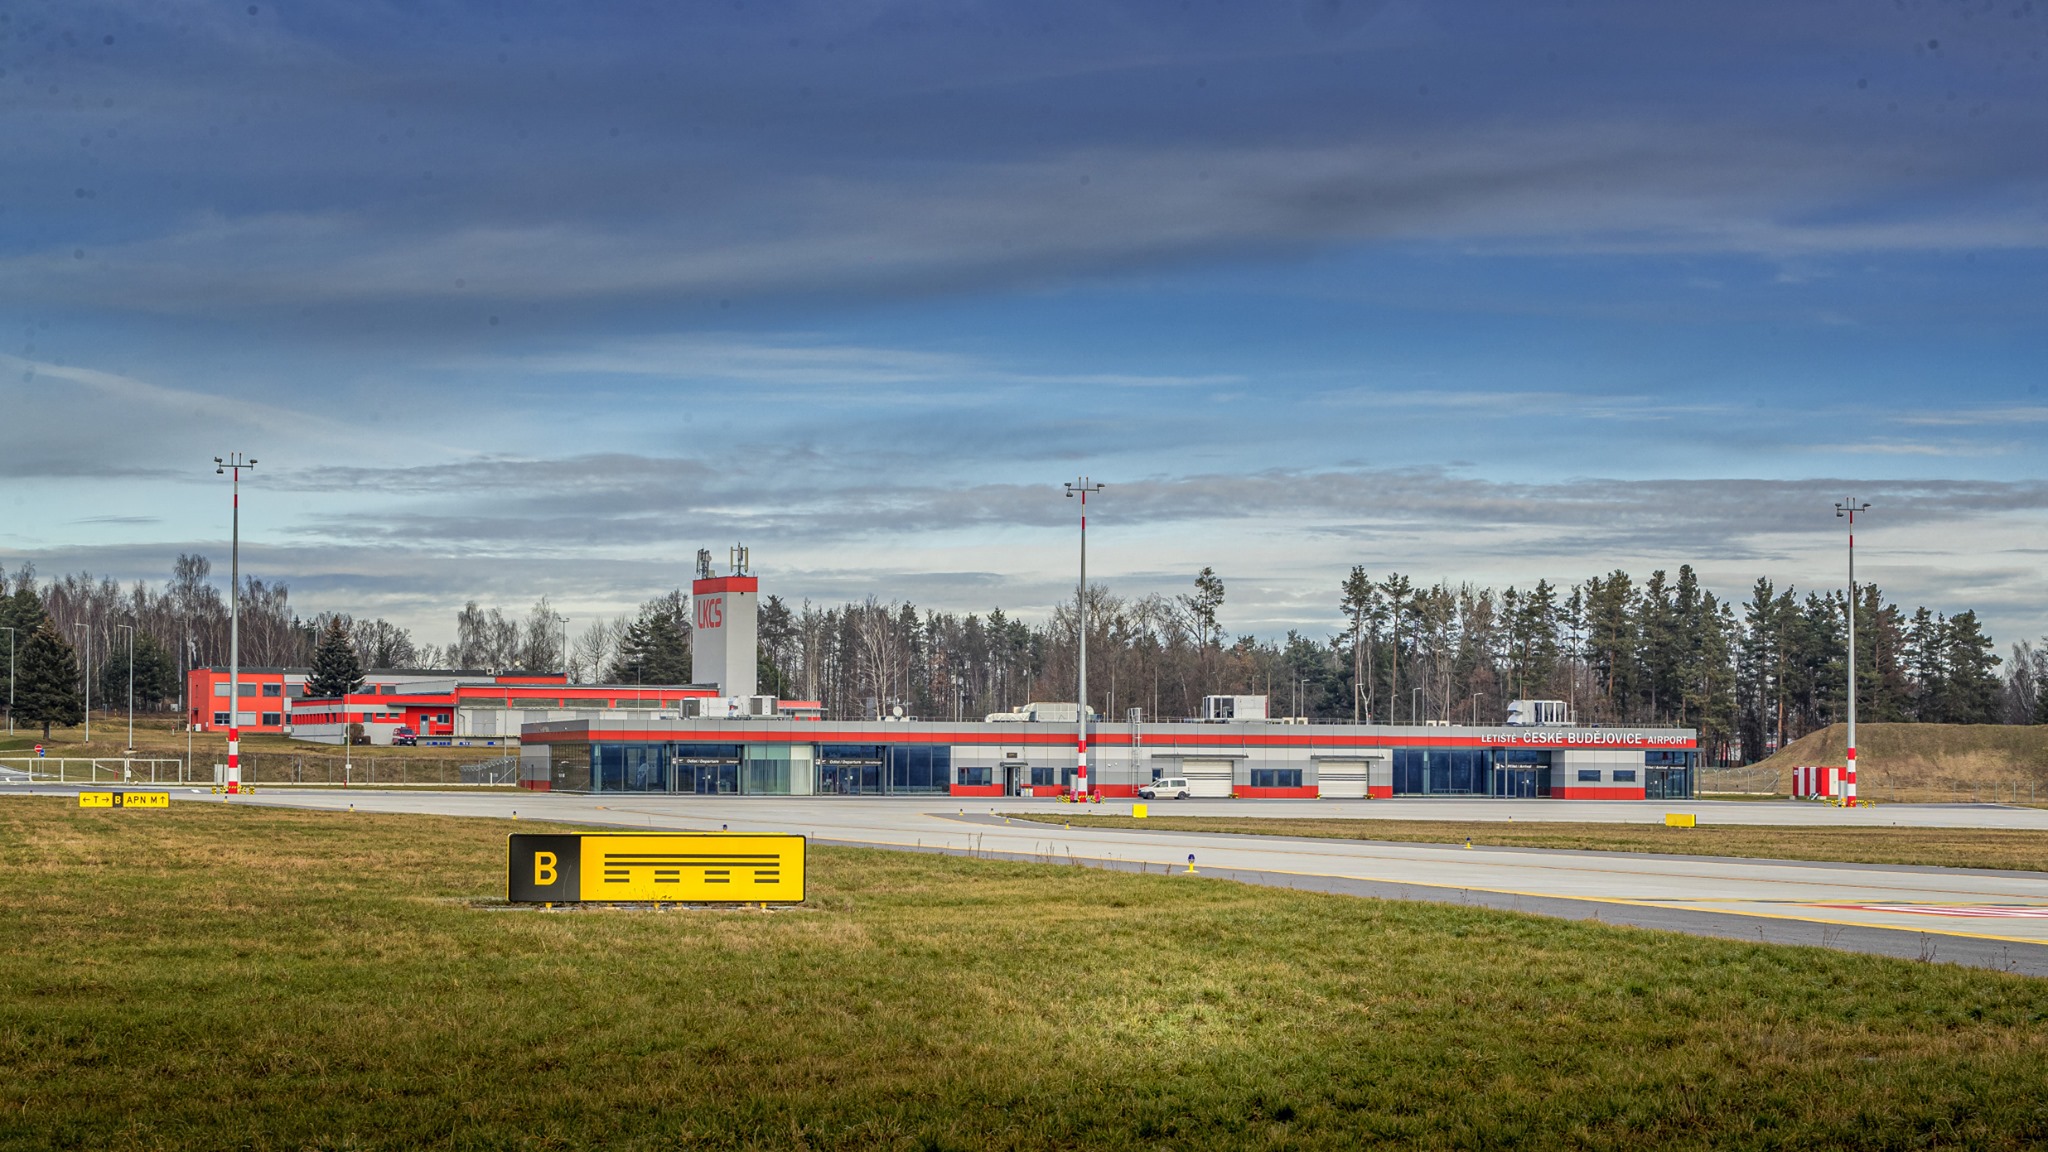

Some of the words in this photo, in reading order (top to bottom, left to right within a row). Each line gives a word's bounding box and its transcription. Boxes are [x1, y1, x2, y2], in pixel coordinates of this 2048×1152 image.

[697, 597, 723, 630] LKCS
[1481, 732, 1517, 743] LETIŠTĚ
[1523, 729, 1563, 744] ČESKÉ
[1567, 730, 1642, 745] BUDĚJOVICE
[1647, 735, 1688, 745] AIRPORT
[115, 796, 121, 804] B
[533, 851, 558, 886] B
